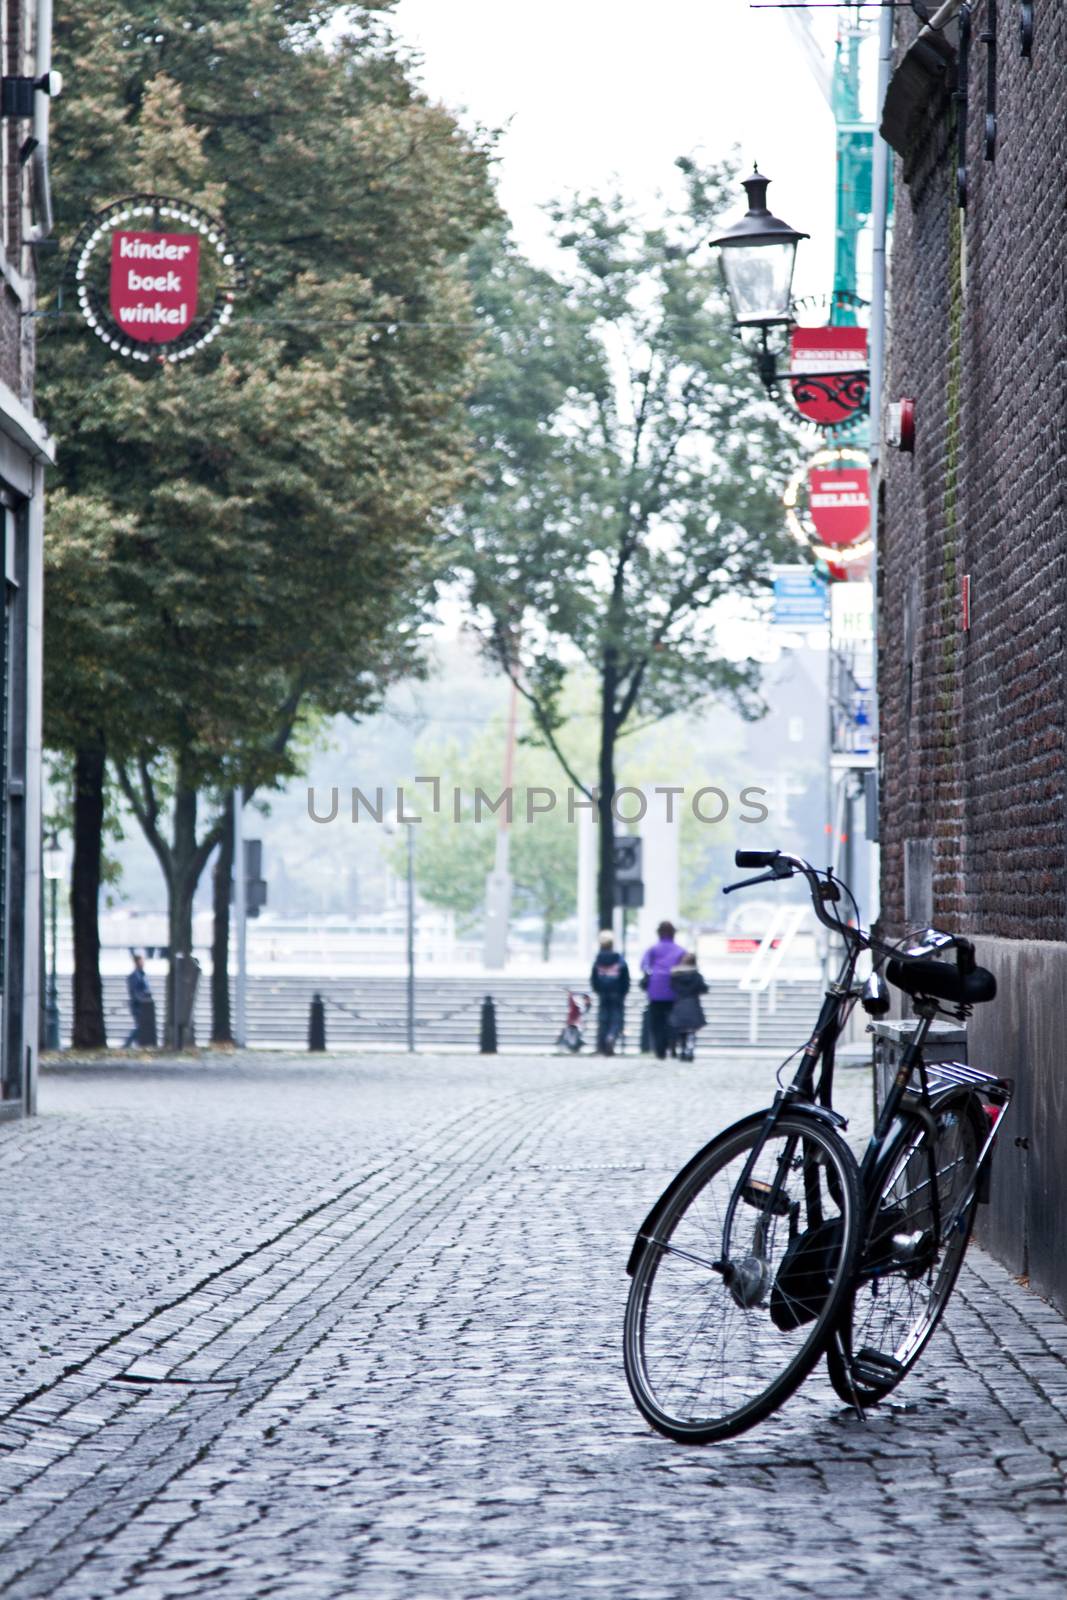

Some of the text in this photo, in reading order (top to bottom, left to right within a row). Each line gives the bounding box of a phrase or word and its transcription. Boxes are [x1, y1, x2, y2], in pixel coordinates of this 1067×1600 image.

[120, 237, 191, 261] kinder
[128, 270, 181, 292] boek
[120, 303, 188, 324] winkel
